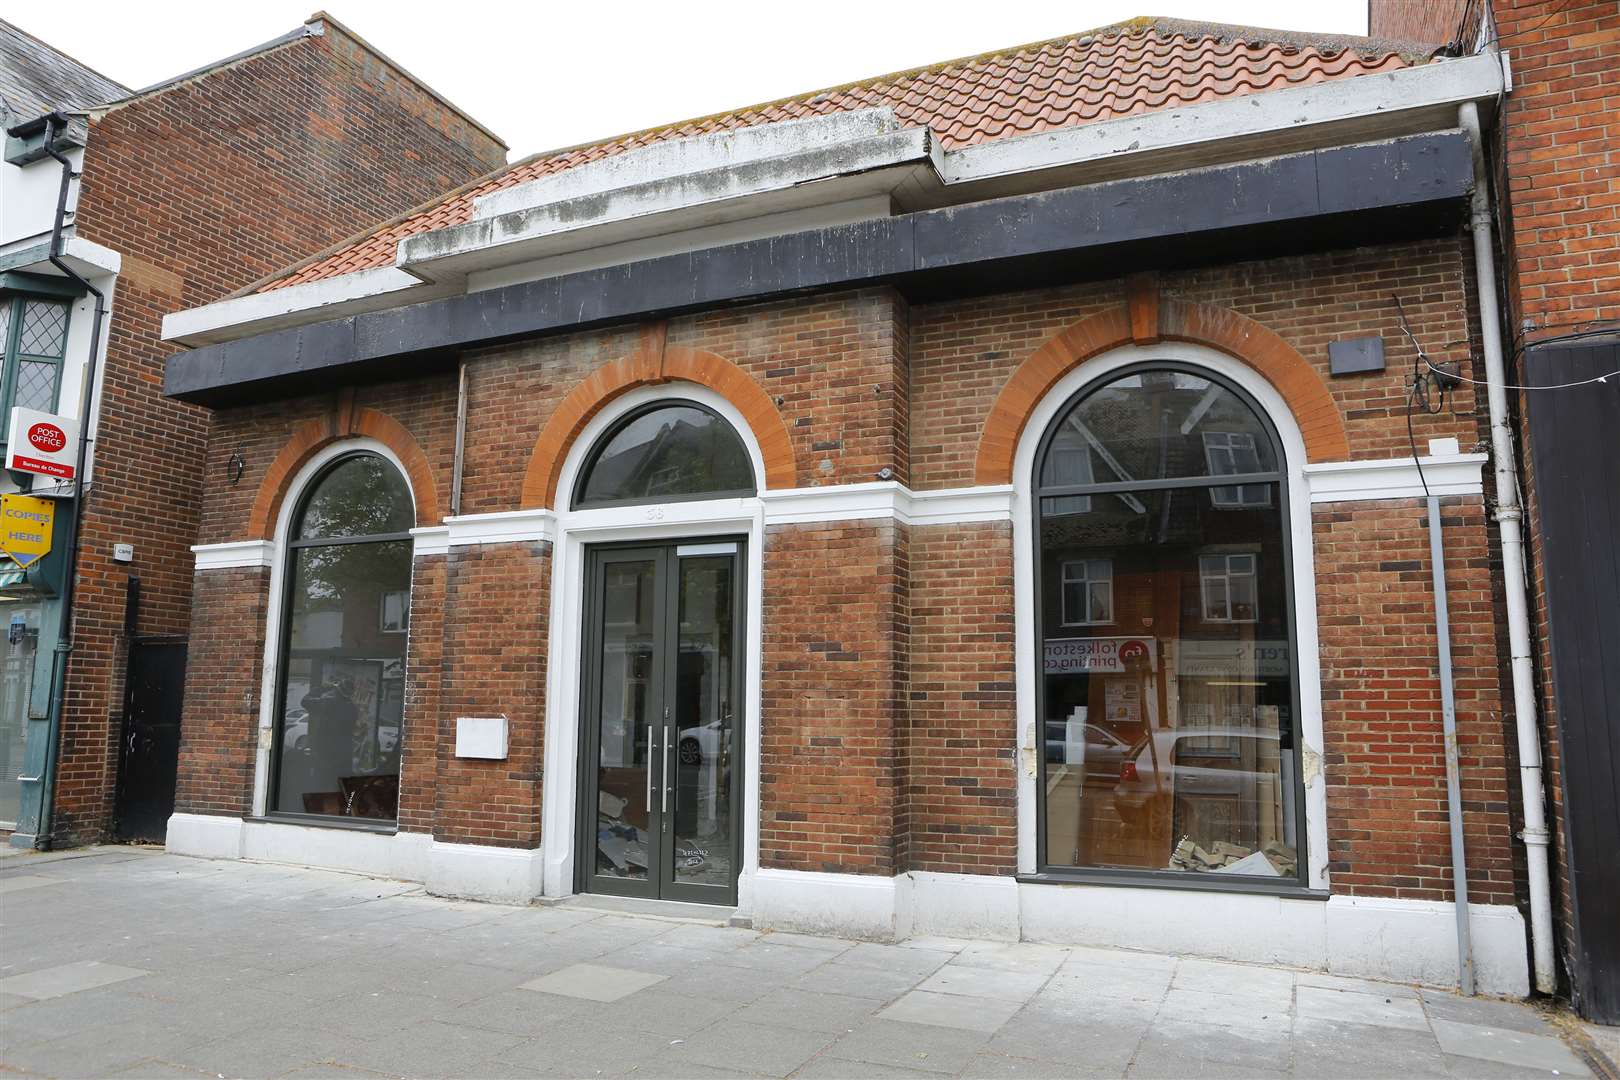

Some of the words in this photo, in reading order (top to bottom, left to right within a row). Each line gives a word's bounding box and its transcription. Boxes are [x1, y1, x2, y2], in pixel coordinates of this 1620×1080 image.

[37, 427, 60, 438] POST
[31, 434, 62, 448] OFFICE
[22, 460, 41, 469] Bureau
[47, 466, 65, 474] Change
[5, 508, 50, 523] COPIES
[8, 531, 43, 543] HERE
